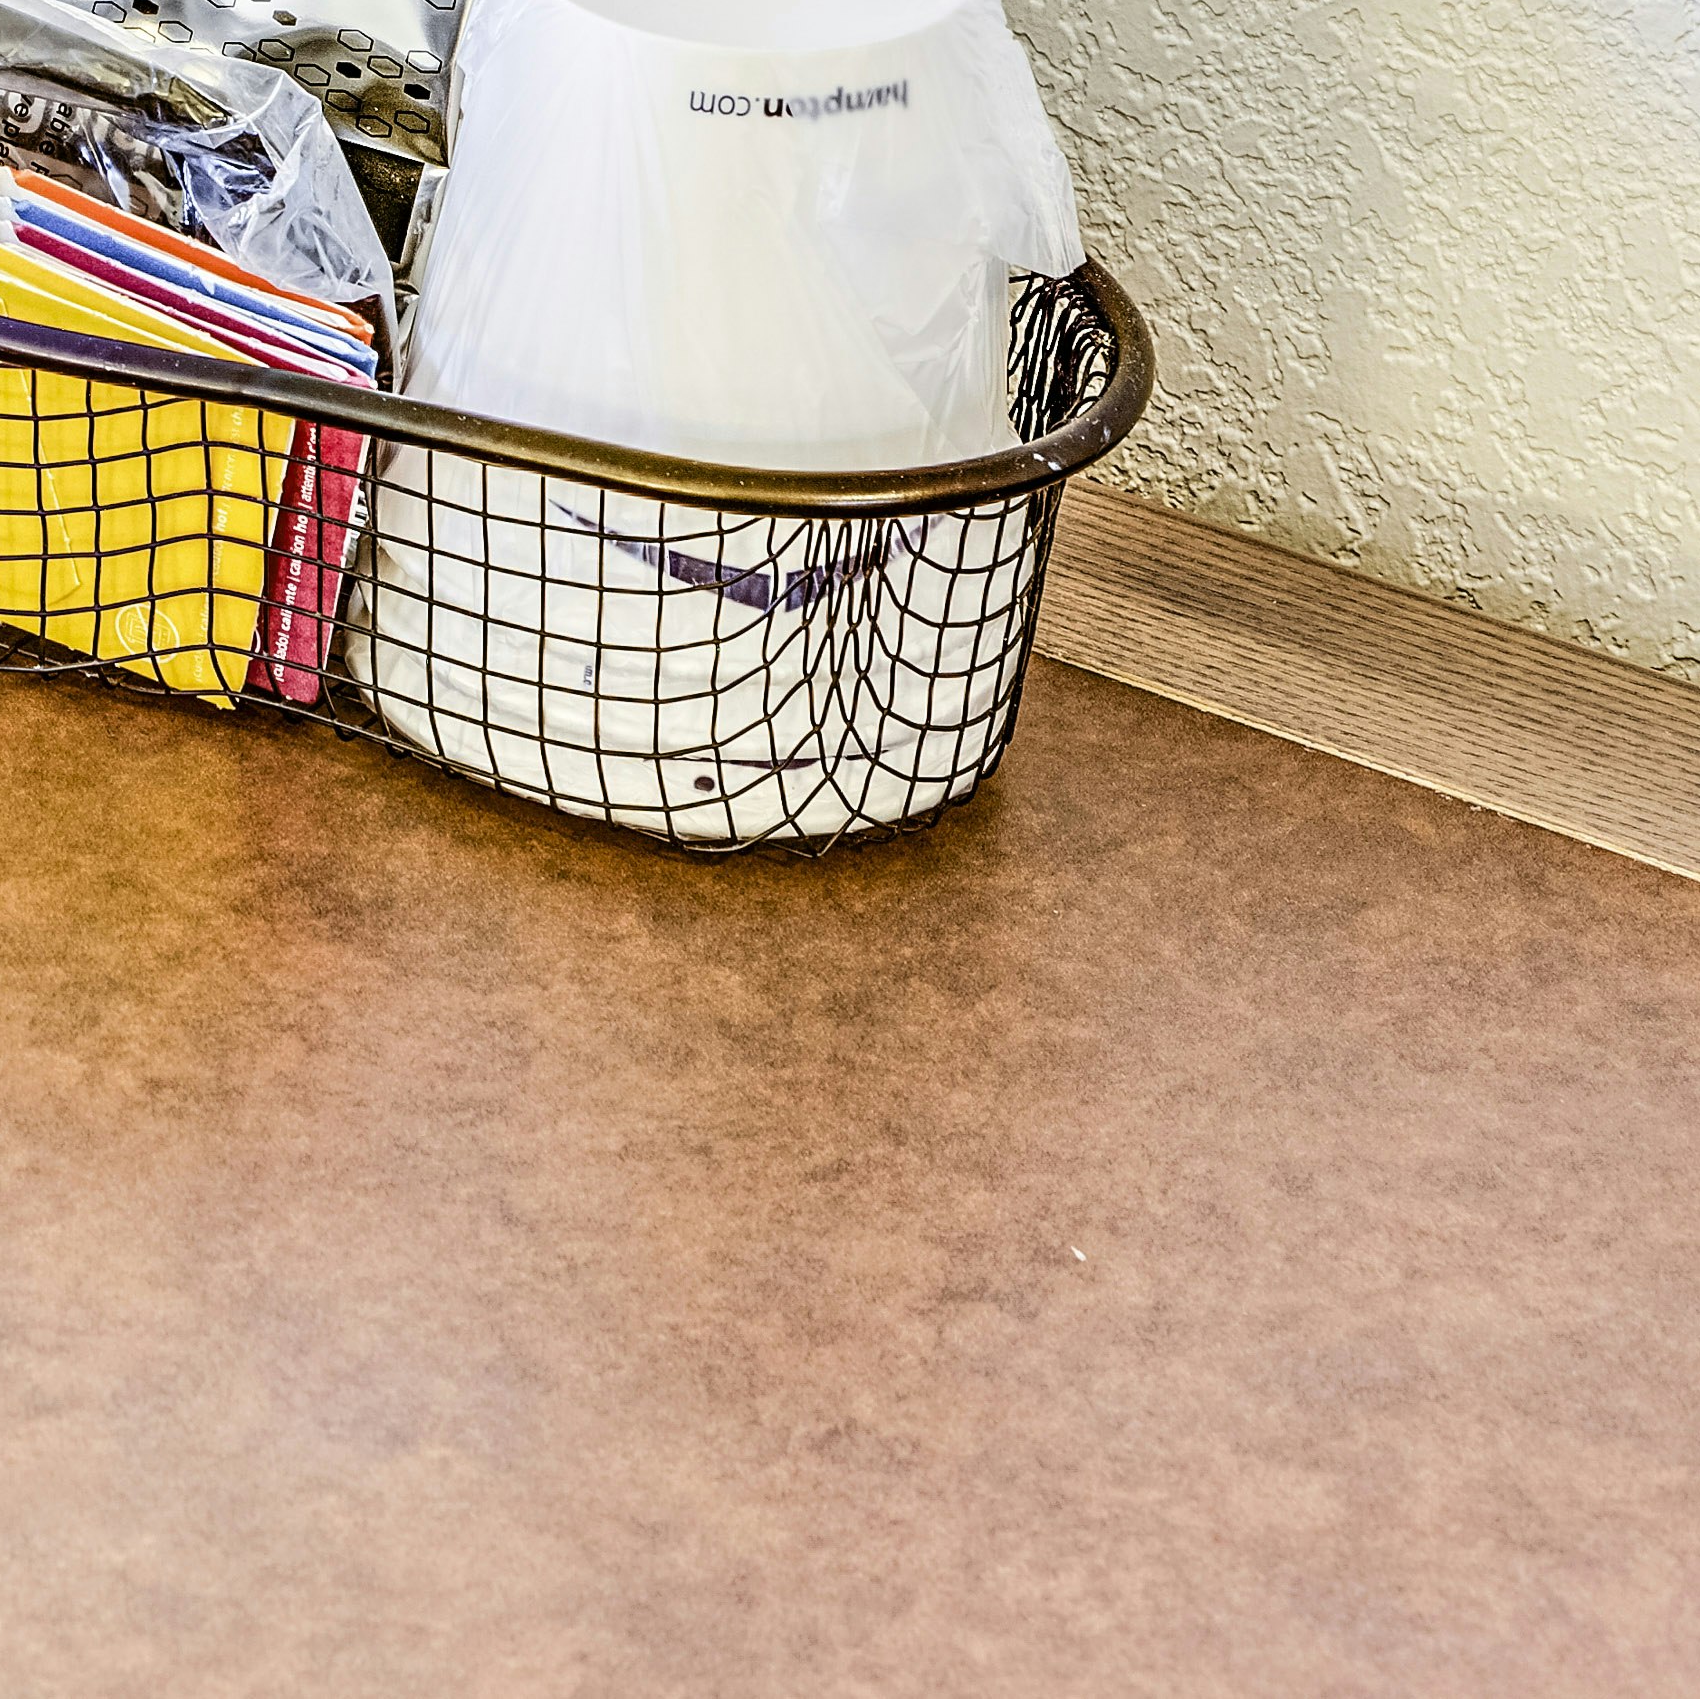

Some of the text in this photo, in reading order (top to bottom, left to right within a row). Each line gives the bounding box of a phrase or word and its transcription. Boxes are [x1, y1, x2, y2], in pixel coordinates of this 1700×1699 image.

[300, 454, 317, 503] attentin
[215, 508, 228, 533] hot
[293, 511, 310, 534] ho
[280, 582, 299, 632] calinte
